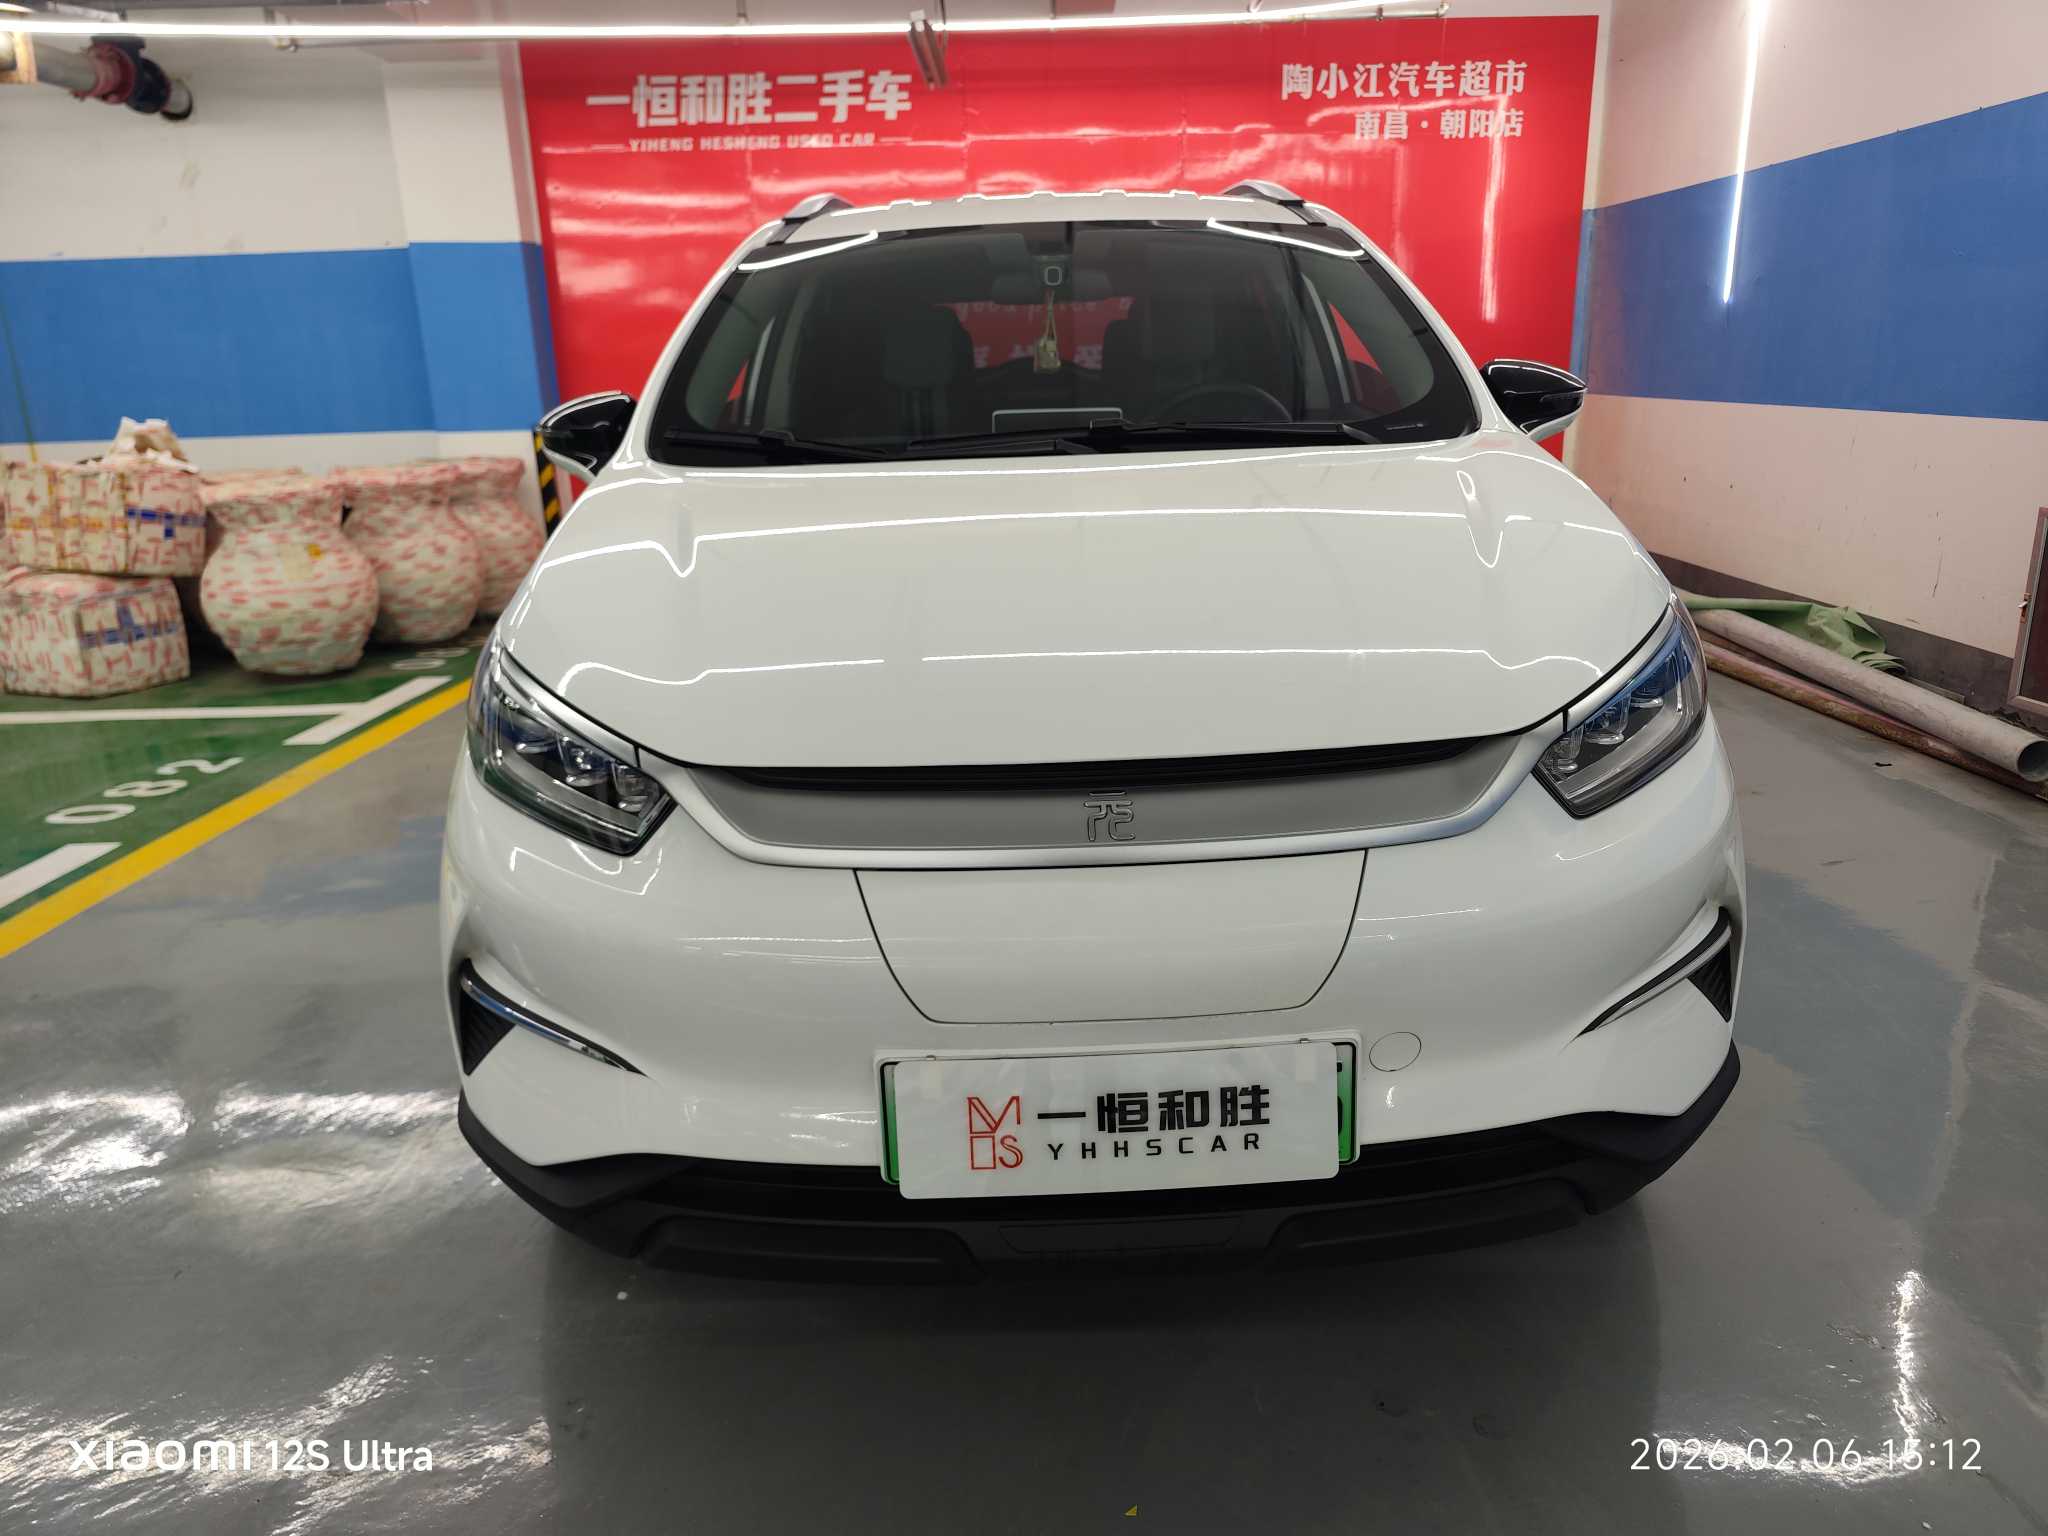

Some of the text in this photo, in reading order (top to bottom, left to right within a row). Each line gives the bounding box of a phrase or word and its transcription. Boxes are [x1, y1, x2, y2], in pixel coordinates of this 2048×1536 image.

[586, 69, 912, 128] 一恒和胜二手车
[1281, 59, 1528, 100] 陶小江汽车超市
[629, 137, 693, 152] YIHENG
[839, 132, 876, 147] CAR
[45, 757, 244, 824] 082
[1037, 1084, 1270, 1133] 一恒和胜
[1048, 1133, 1260, 1161] YHHSCAR
